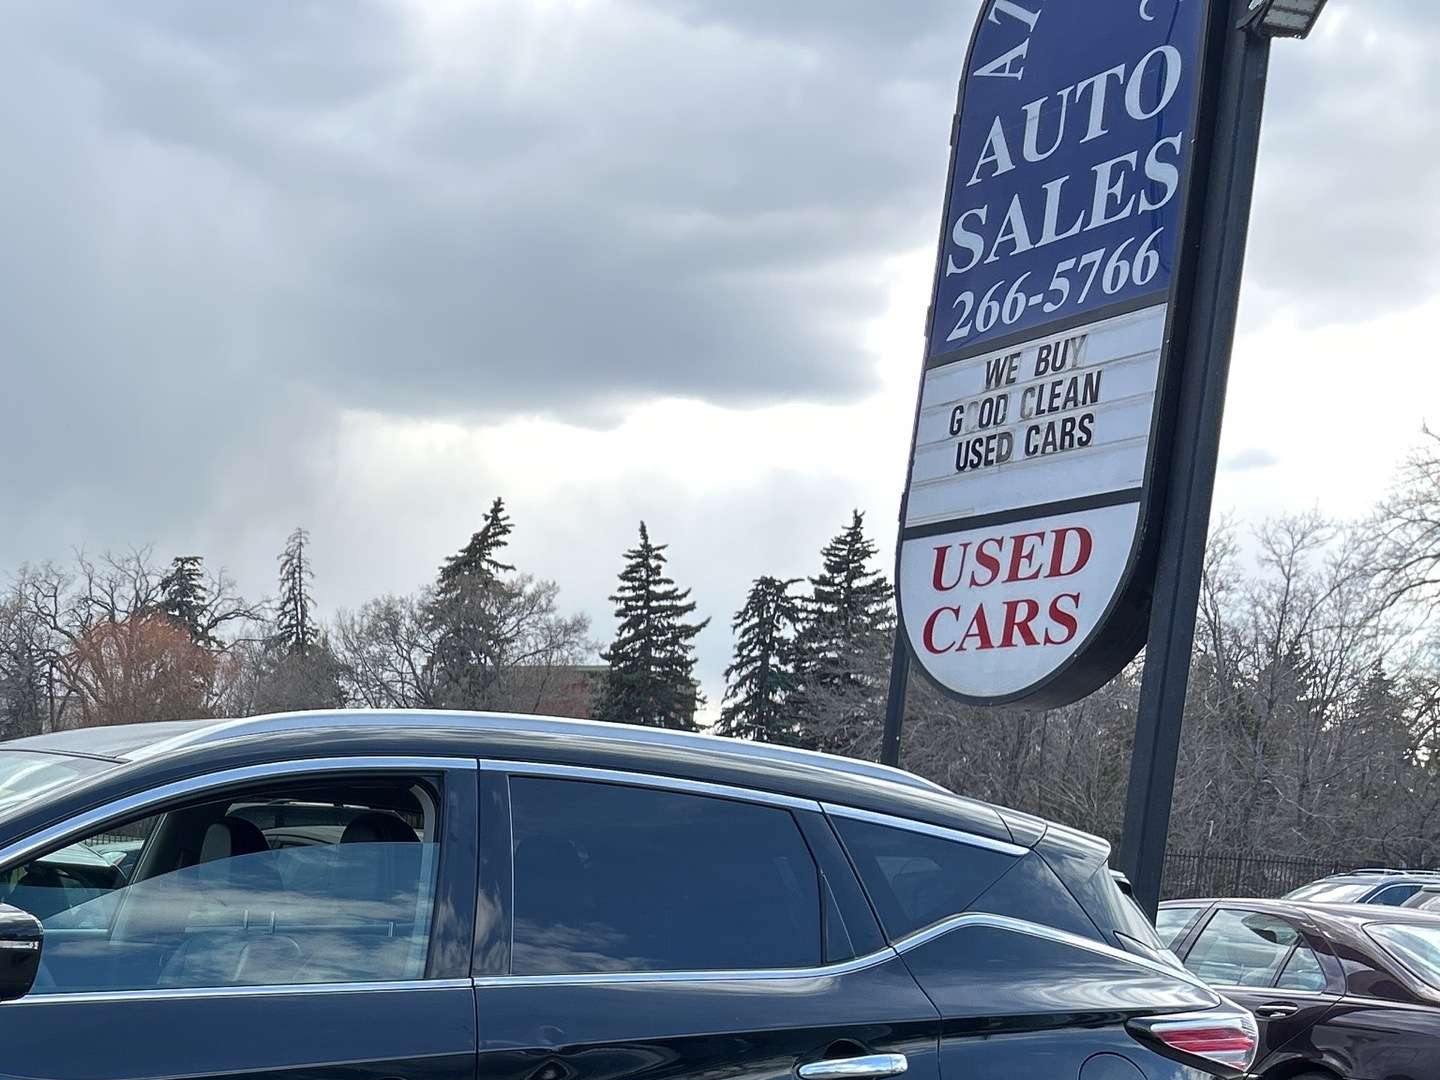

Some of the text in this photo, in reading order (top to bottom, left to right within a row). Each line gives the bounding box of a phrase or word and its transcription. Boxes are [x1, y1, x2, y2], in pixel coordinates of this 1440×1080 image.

[966, 44, 1182, 187] AUTO
[946, 131, 1183, 277] SALES
[946, 227, 1164, 342] 266-5766
[985, 334, 1088, 390] WE BUY
[1020, 370, 1103, 419] CLEAN
[955, 413, 1094, 471] USED CARS
[932, 526, 1093, 591] USED
[922, 592, 1081, 655] CARS
